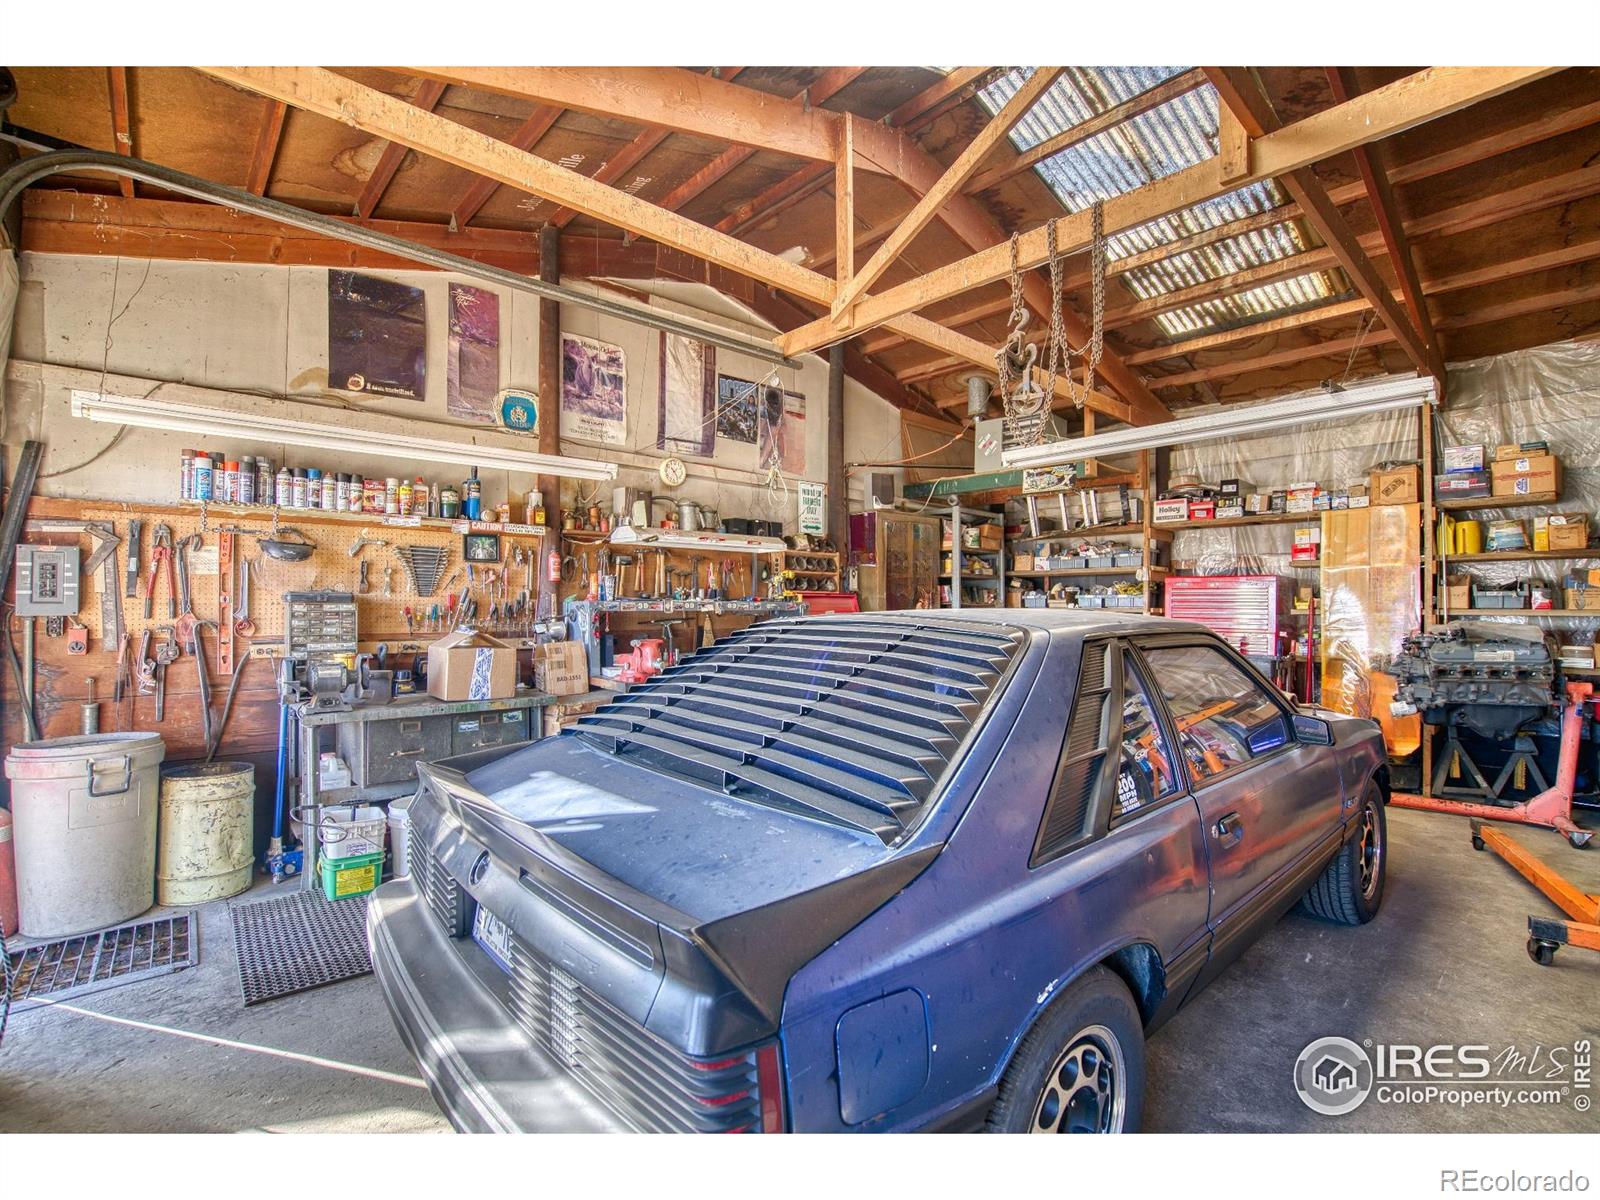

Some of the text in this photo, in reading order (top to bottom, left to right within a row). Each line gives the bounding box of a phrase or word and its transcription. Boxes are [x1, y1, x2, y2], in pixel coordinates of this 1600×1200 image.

[1158, 505, 1181, 515] Holley
[471, 521, 501, 532] CAUTION
[1118, 775, 1135, 795] 200
[1119, 789, 1138, 803] MPH
